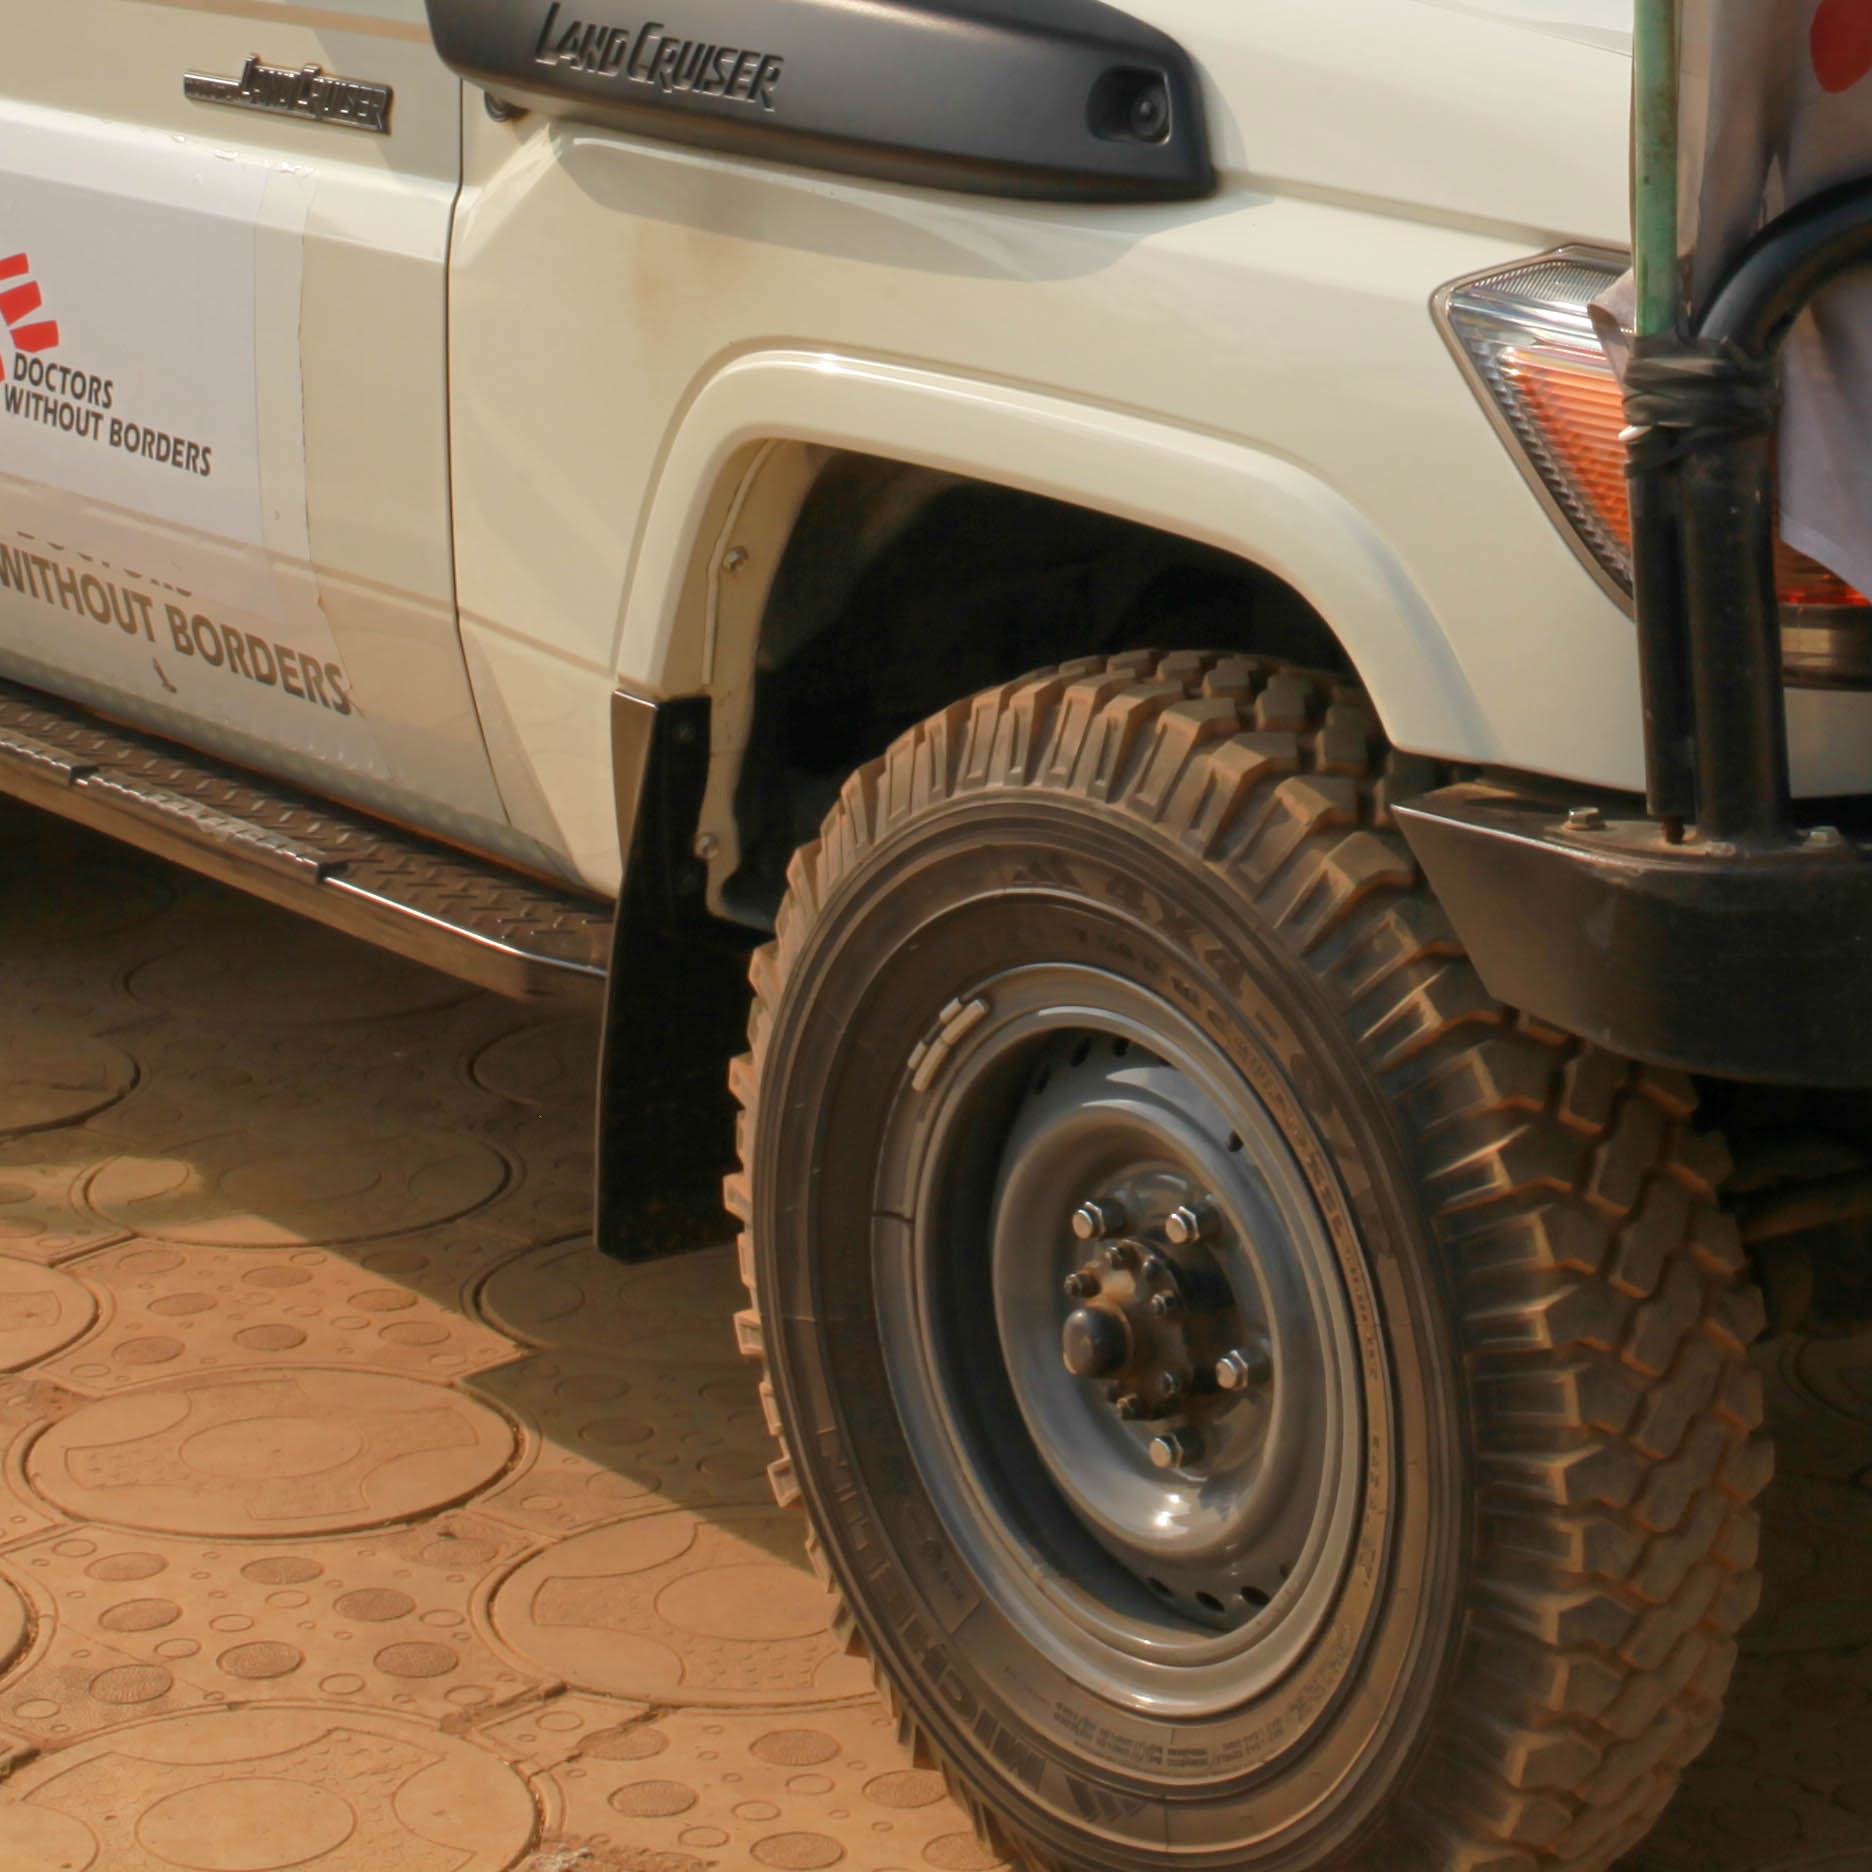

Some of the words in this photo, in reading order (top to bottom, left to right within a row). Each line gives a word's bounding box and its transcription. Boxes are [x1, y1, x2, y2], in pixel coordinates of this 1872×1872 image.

[535, 1, 630, 78] LAND
[627, 21, 785, 113] CRUISER
[4, 383, 104, 442] WITHOUT
[109, 417, 212, 477] BORDERS
[14, 351, 114, 410] DOCTORS
[165, 603, 354, 716] BORDERS
